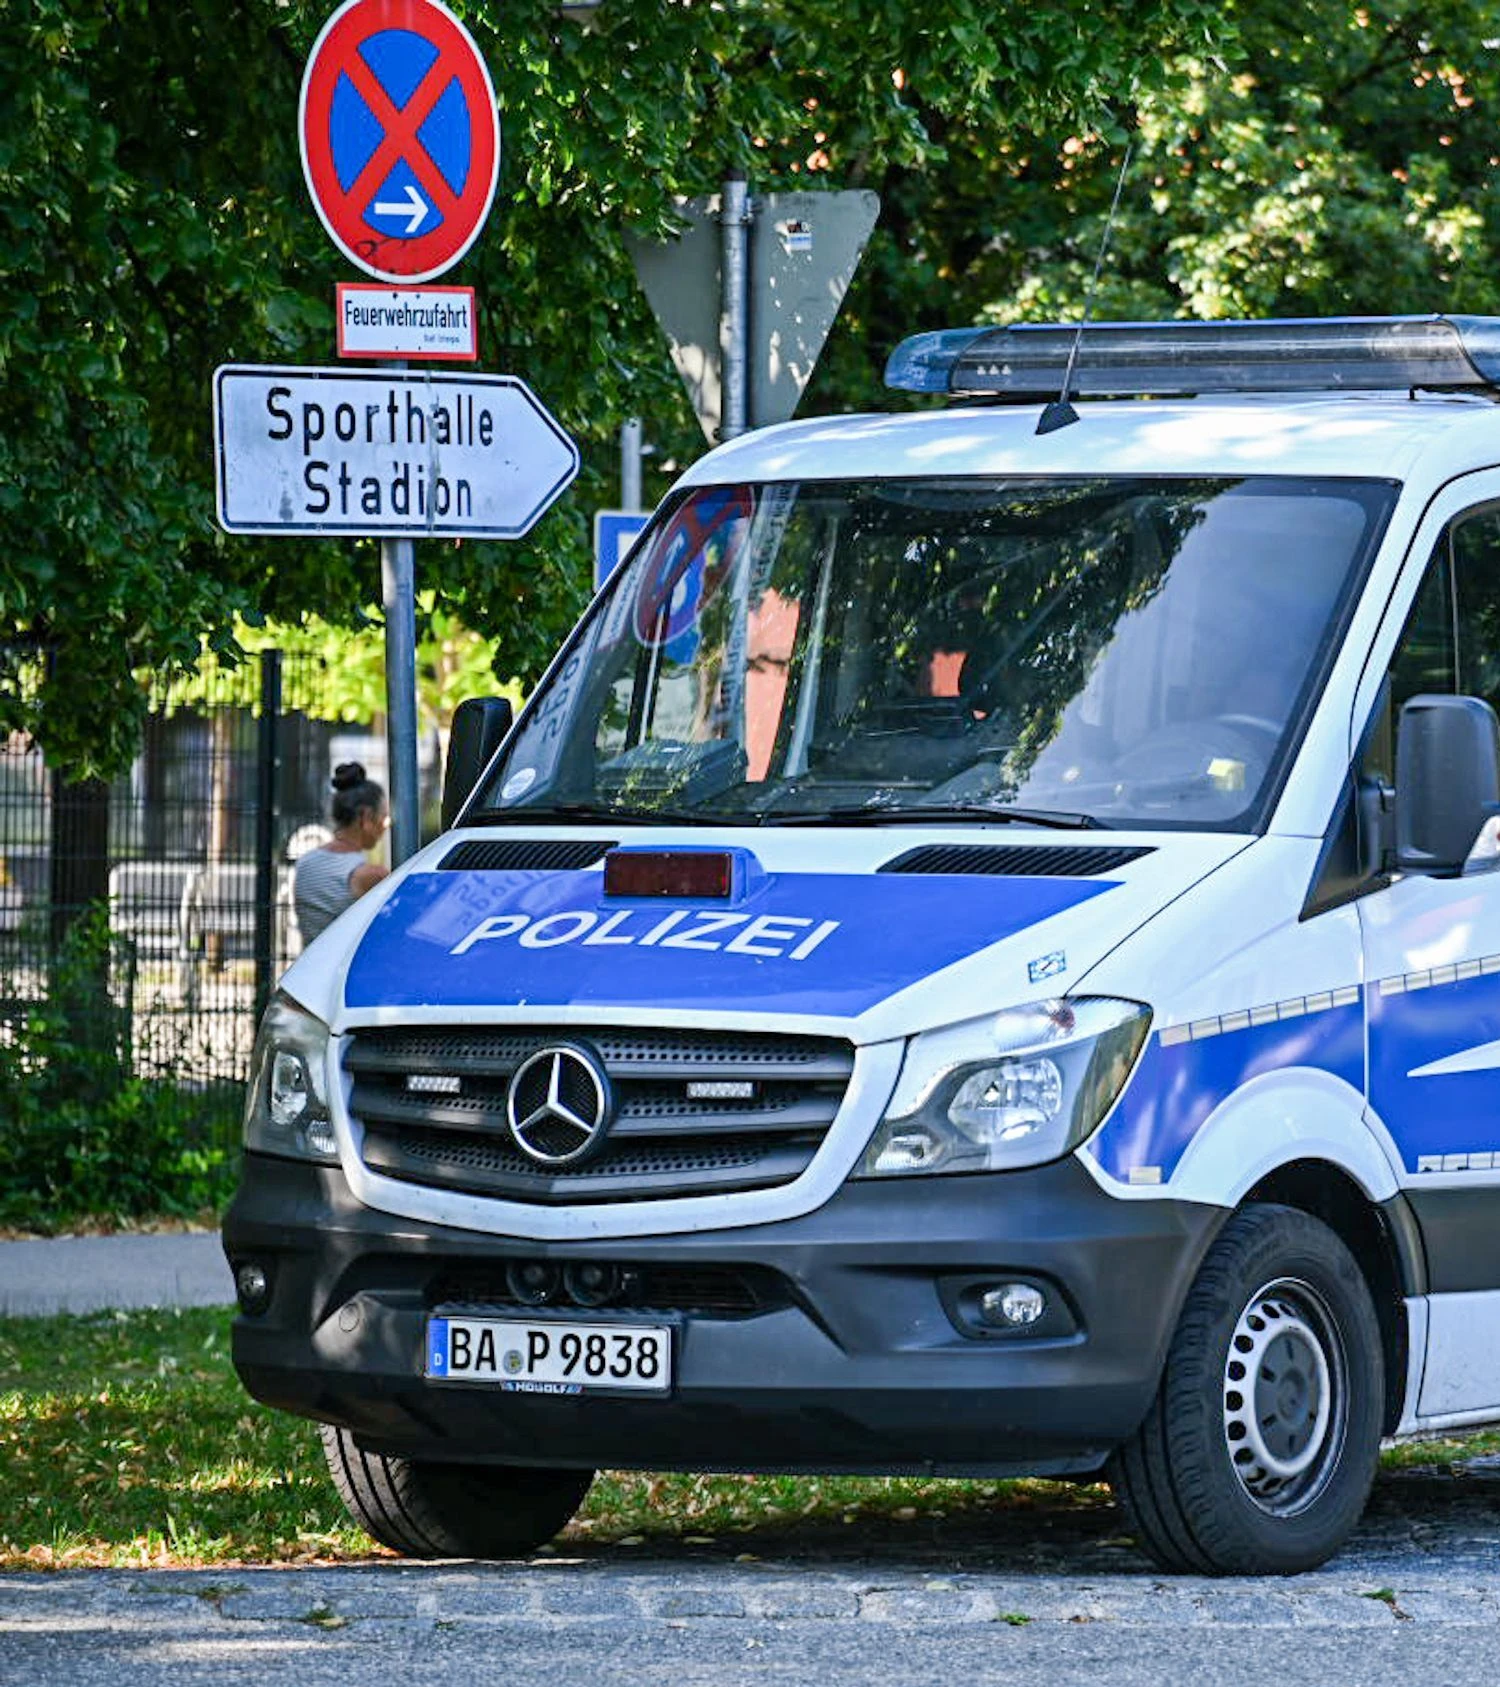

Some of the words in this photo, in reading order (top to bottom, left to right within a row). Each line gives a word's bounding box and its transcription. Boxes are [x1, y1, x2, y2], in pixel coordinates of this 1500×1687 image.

[344, 300, 468, 328] Feuerwehrzufahrt
[266, 386, 494, 456] Sporthalle
[303, 460, 473, 517] Stadion
[449, 910, 841, 960] POLIZEI
[434, 1354, 443, 1367] D
[451, 1327, 497, 1371] BA
[527, 1331, 550, 1373] P
[559, 1333, 659, 1378] 9838
